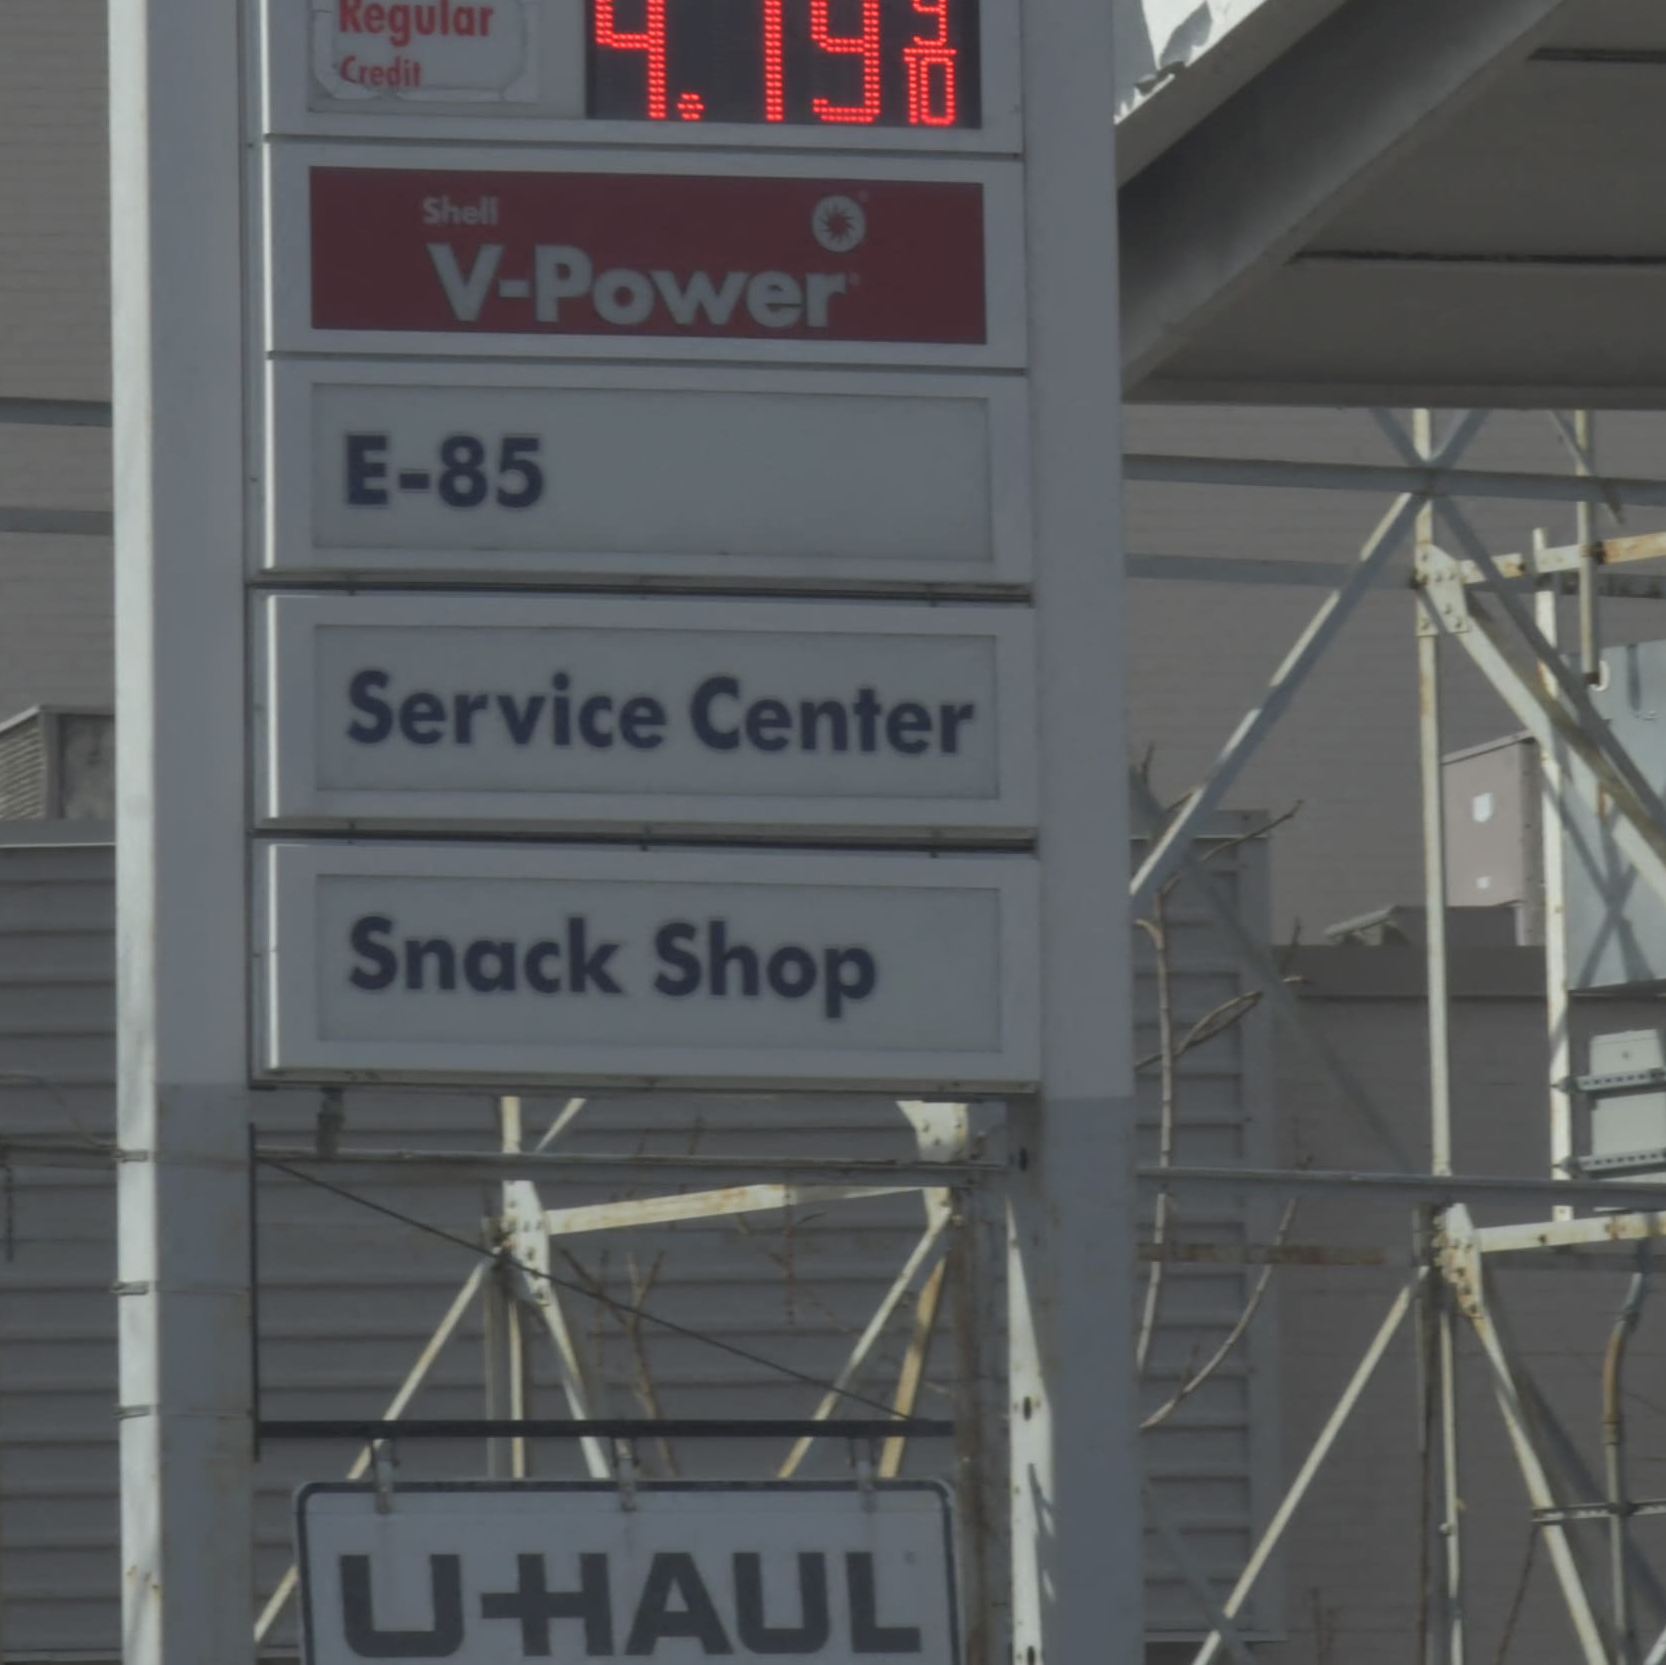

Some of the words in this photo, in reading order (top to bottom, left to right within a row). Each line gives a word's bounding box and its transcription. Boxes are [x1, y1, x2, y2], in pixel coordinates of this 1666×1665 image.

[338, 54, 423, 89] Credit
[421, 194, 500, 227] Shell
[424, 241, 850, 330] V-Power
[345, 434, 546, 510] E-85
[345, 668, 668, 750] Service
[688, 674, 976, 756] Center
[347, 914, 624, 996] Snack
[652, 919, 878, 1020] Shop
[338, 1550, 922, 1659] U-HAUL
